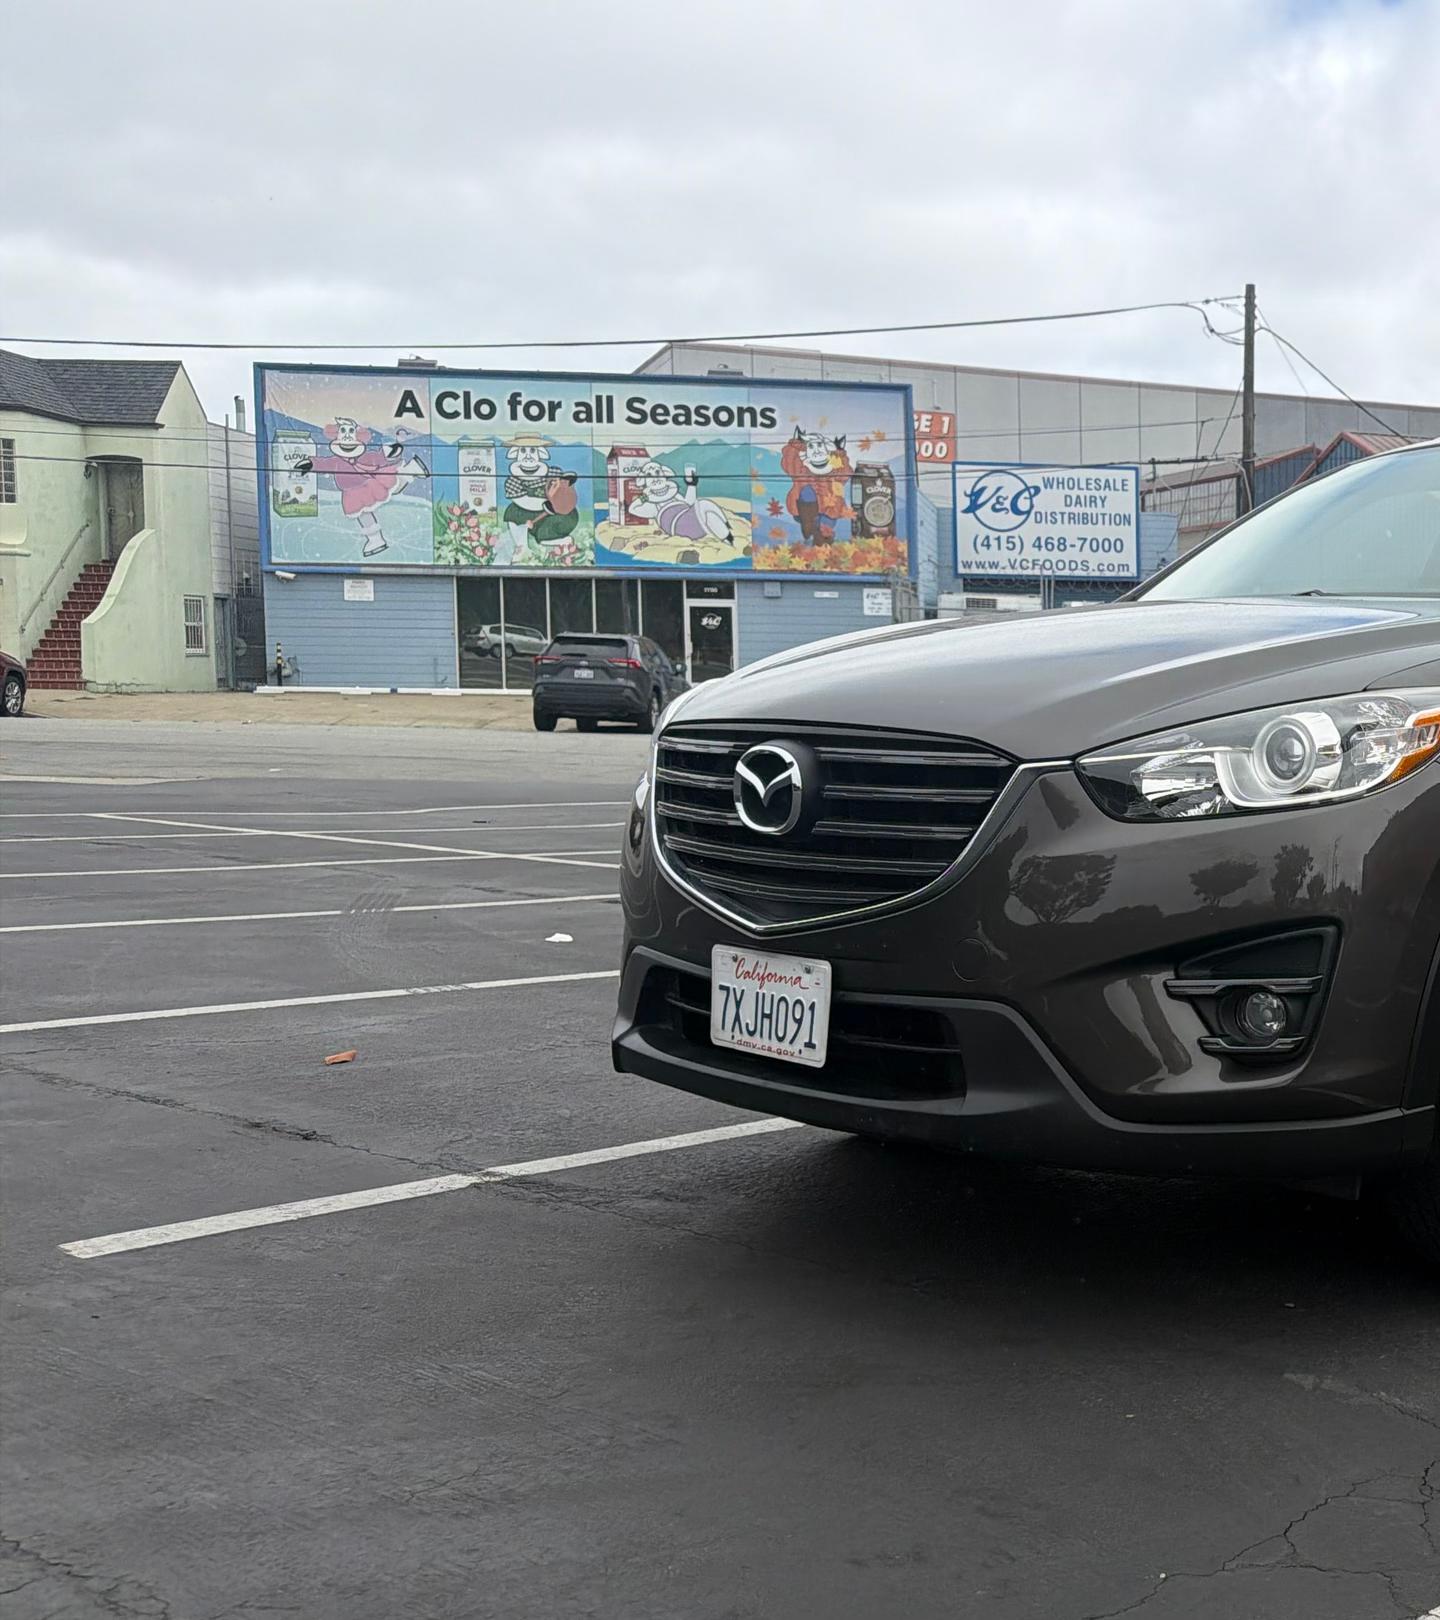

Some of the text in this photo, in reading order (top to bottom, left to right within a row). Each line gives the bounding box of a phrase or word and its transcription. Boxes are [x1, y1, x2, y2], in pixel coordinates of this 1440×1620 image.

[394, 389, 778, 429] A Clo for all Seasons
[463, 465, 492, 474] CLOVER
[865, 486, 892, 495] CLOVER
[1042, 477, 1129, 492] WHOLESALE
[961, 485, 1041, 516] V&C
[1064, 494, 1108, 509] DAIRY
[1034, 511, 1132, 527] DISTRIBUTION
[972, 534, 1124, 554] (415) 468-7000
[961, 558, 1130, 573] www.VCFOODS.com
[735, 957, 810, 990] California
[718, 984, 817, 1050] 7XJH091
[736, 1039, 796, 1057] dmv.ca.gov
